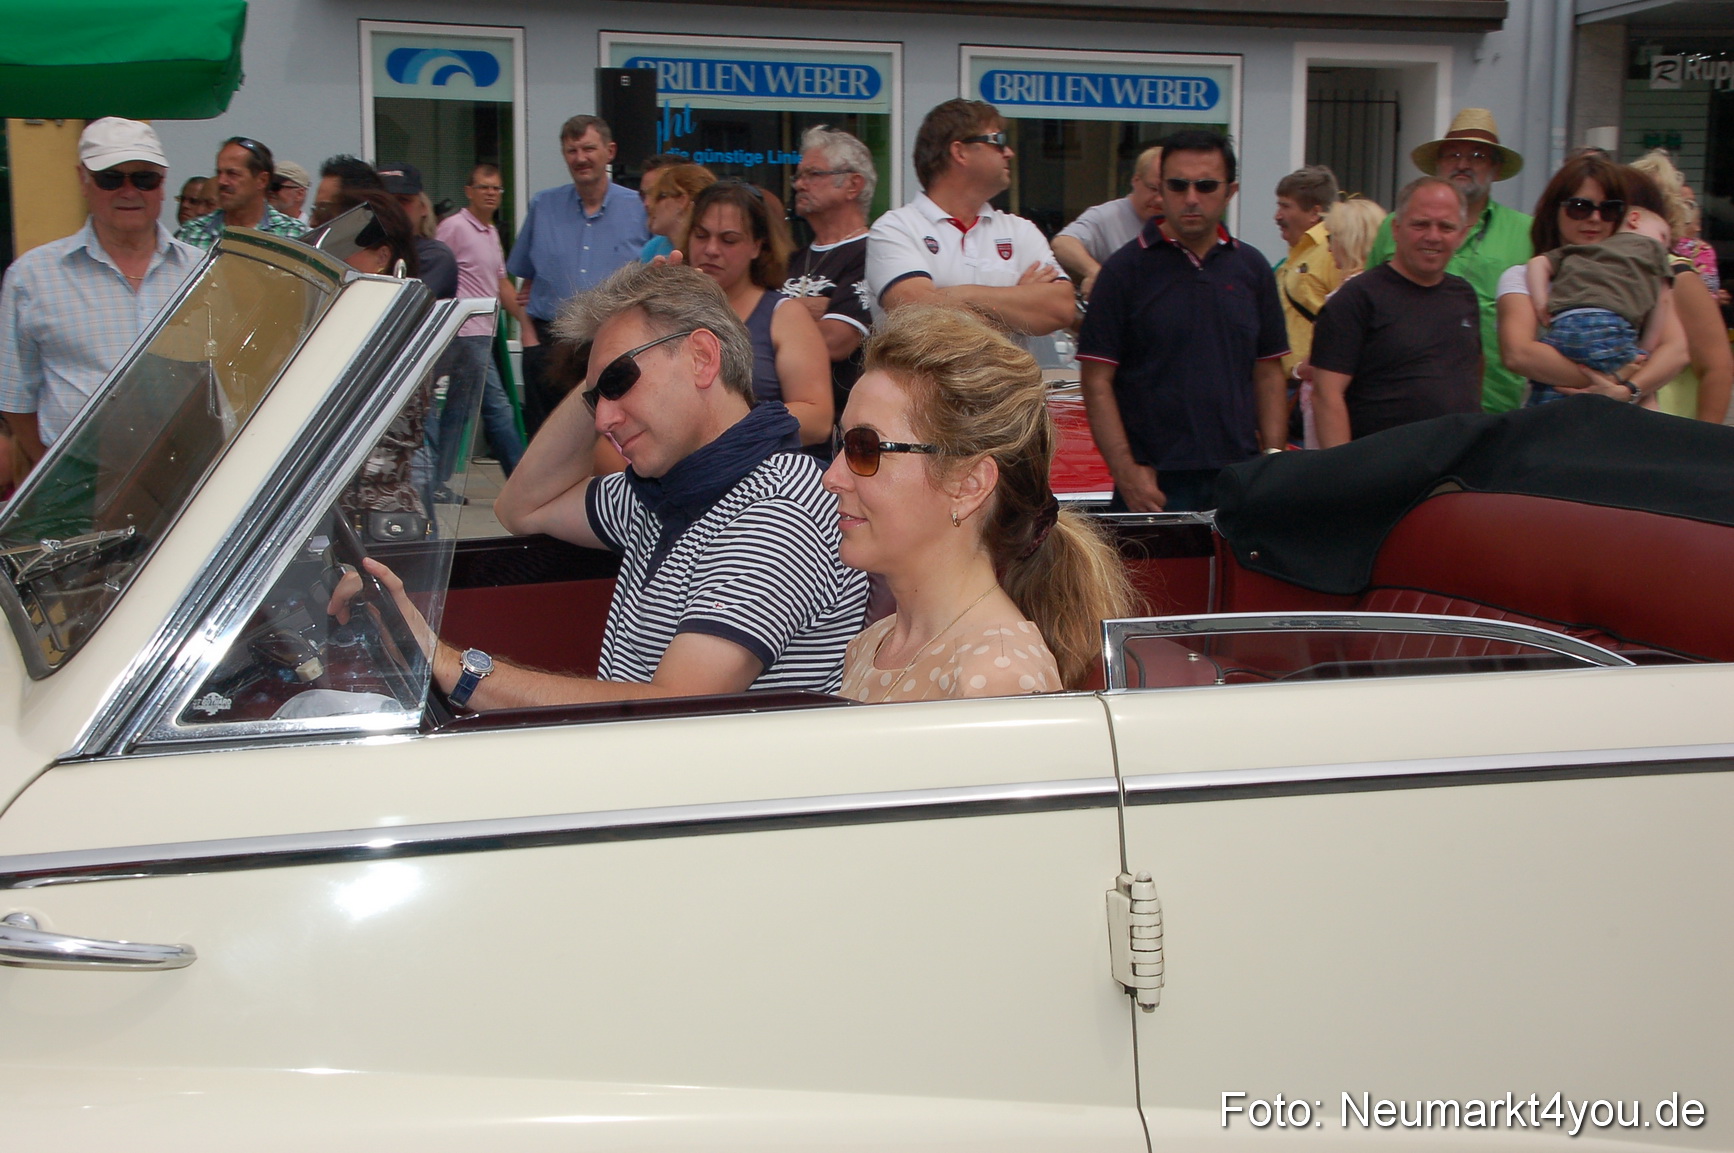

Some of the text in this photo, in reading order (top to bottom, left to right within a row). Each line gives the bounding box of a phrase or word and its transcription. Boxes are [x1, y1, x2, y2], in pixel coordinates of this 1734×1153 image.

[637, 60, 871, 97] RILLEN WEBER
[994, 73, 1209, 107] BRILLEN WEBER
[692, 148, 764, 167] günstige
